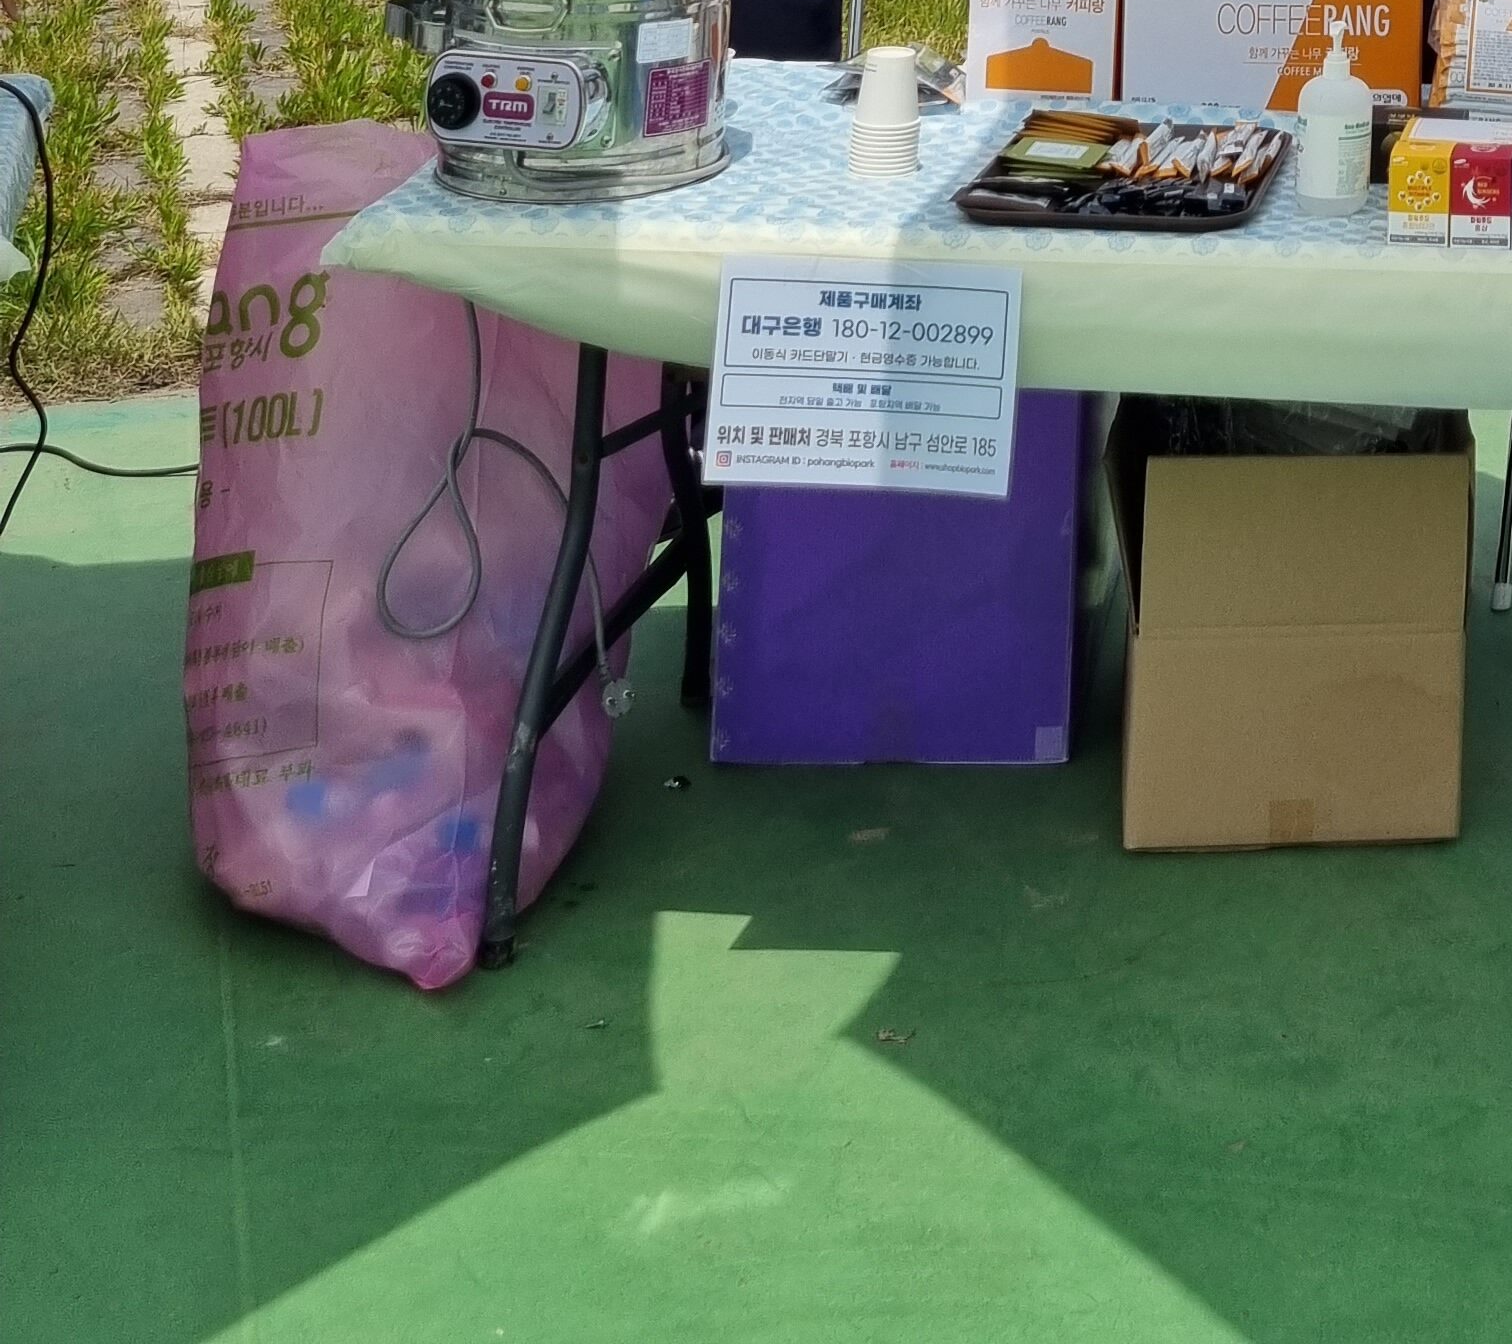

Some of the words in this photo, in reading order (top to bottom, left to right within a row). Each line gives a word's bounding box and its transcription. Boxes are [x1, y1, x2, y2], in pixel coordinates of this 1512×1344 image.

[1302, 47, 1322, 60] 나무
[488, 99, 528, 113] TRM
[818, 290, 923, 312] 제품구매계좌
[741, 315, 823, 338] 대구은행
[832, 318, 994, 346] 180-12-002899
[751, 348, 787, 361] 이동식
[790, 349, 848, 363] 카드단말기
[716, 425, 746, 445] 위치
[750, 426, 765, 445] 및
[768, 426, 812, 447] 판매처
[816, 428, 844, 448] 경북
[847, 429, 890, 450] 포항시
[894, 432, 922, 453] 남구
[926, 434, 968, 455] 섬안로
[972, 436, 997, 458] 185
